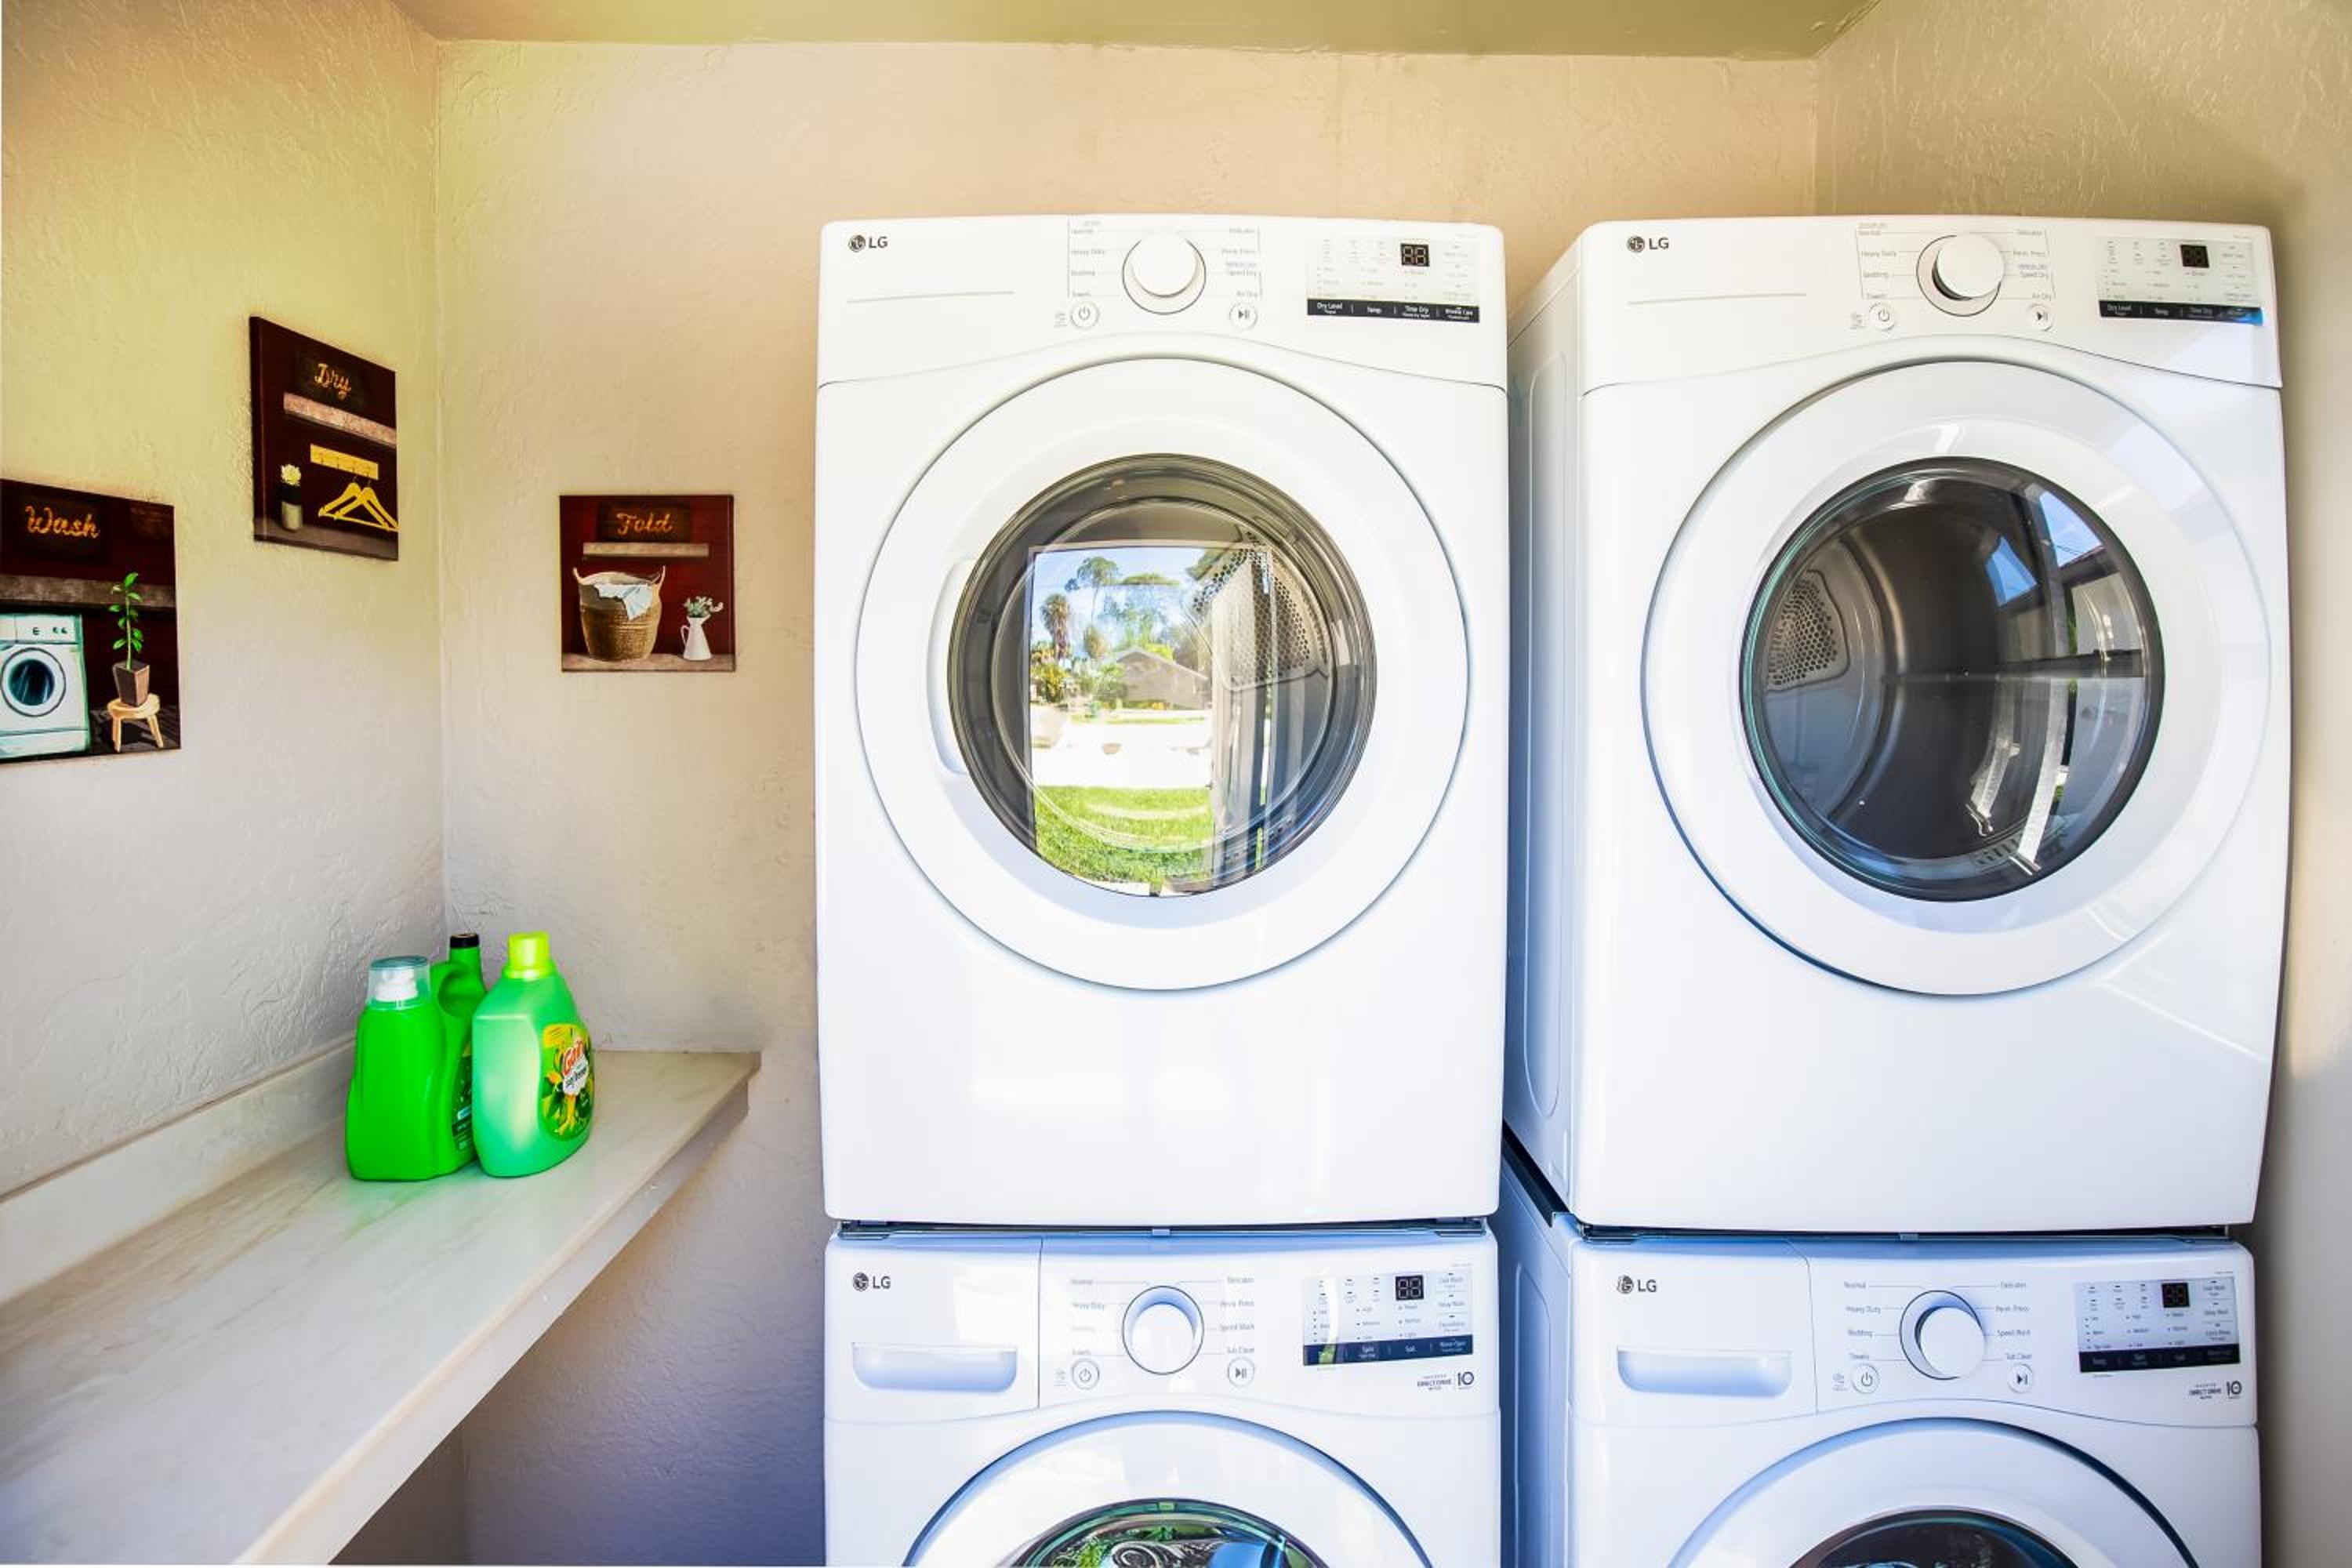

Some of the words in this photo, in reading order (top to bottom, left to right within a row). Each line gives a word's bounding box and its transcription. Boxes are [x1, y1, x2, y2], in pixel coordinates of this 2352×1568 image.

[869, 236, 887, 249] LG
[1649, 237, 1668, 250] LG
[314, 362, 352, 398] Dry
[24, 503, 100, 540] Wash
[615, 512, 673, 535] Fold
[873, 1276, 891, 1290] LG
[1638, 1279, 1657, 1293] LG
